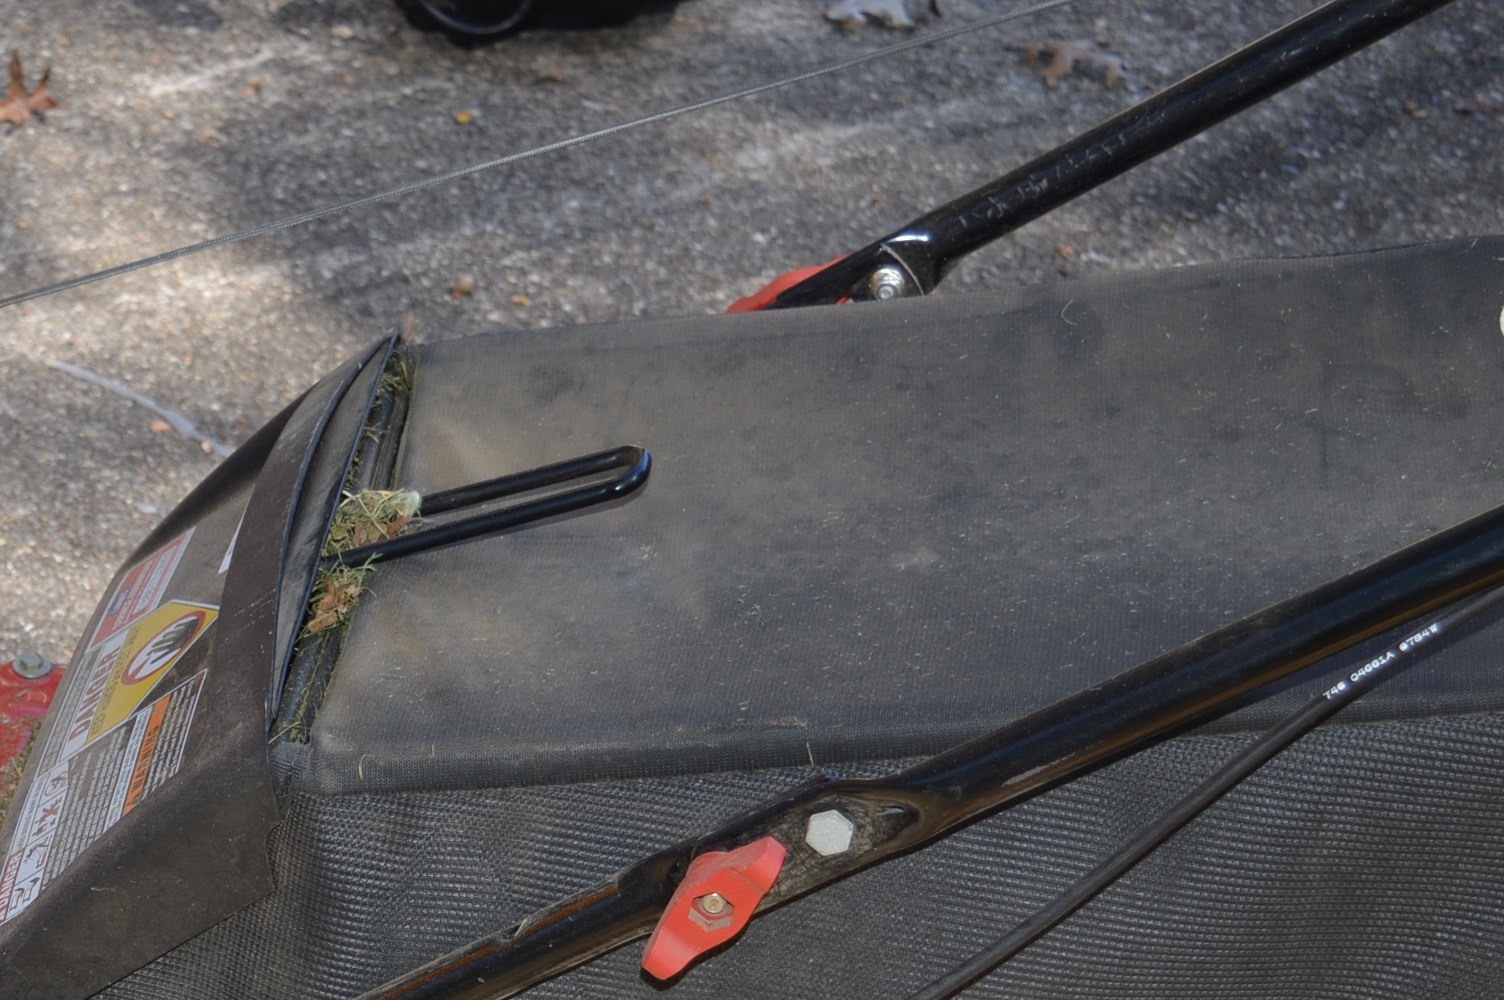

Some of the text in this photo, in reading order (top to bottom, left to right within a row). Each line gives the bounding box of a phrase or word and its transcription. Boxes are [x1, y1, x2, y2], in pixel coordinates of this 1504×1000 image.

[68, 647, 121, 742] DANGER
[133, 725, 160, 792] WARNING
[0, 852, 23, 908] DANGER
